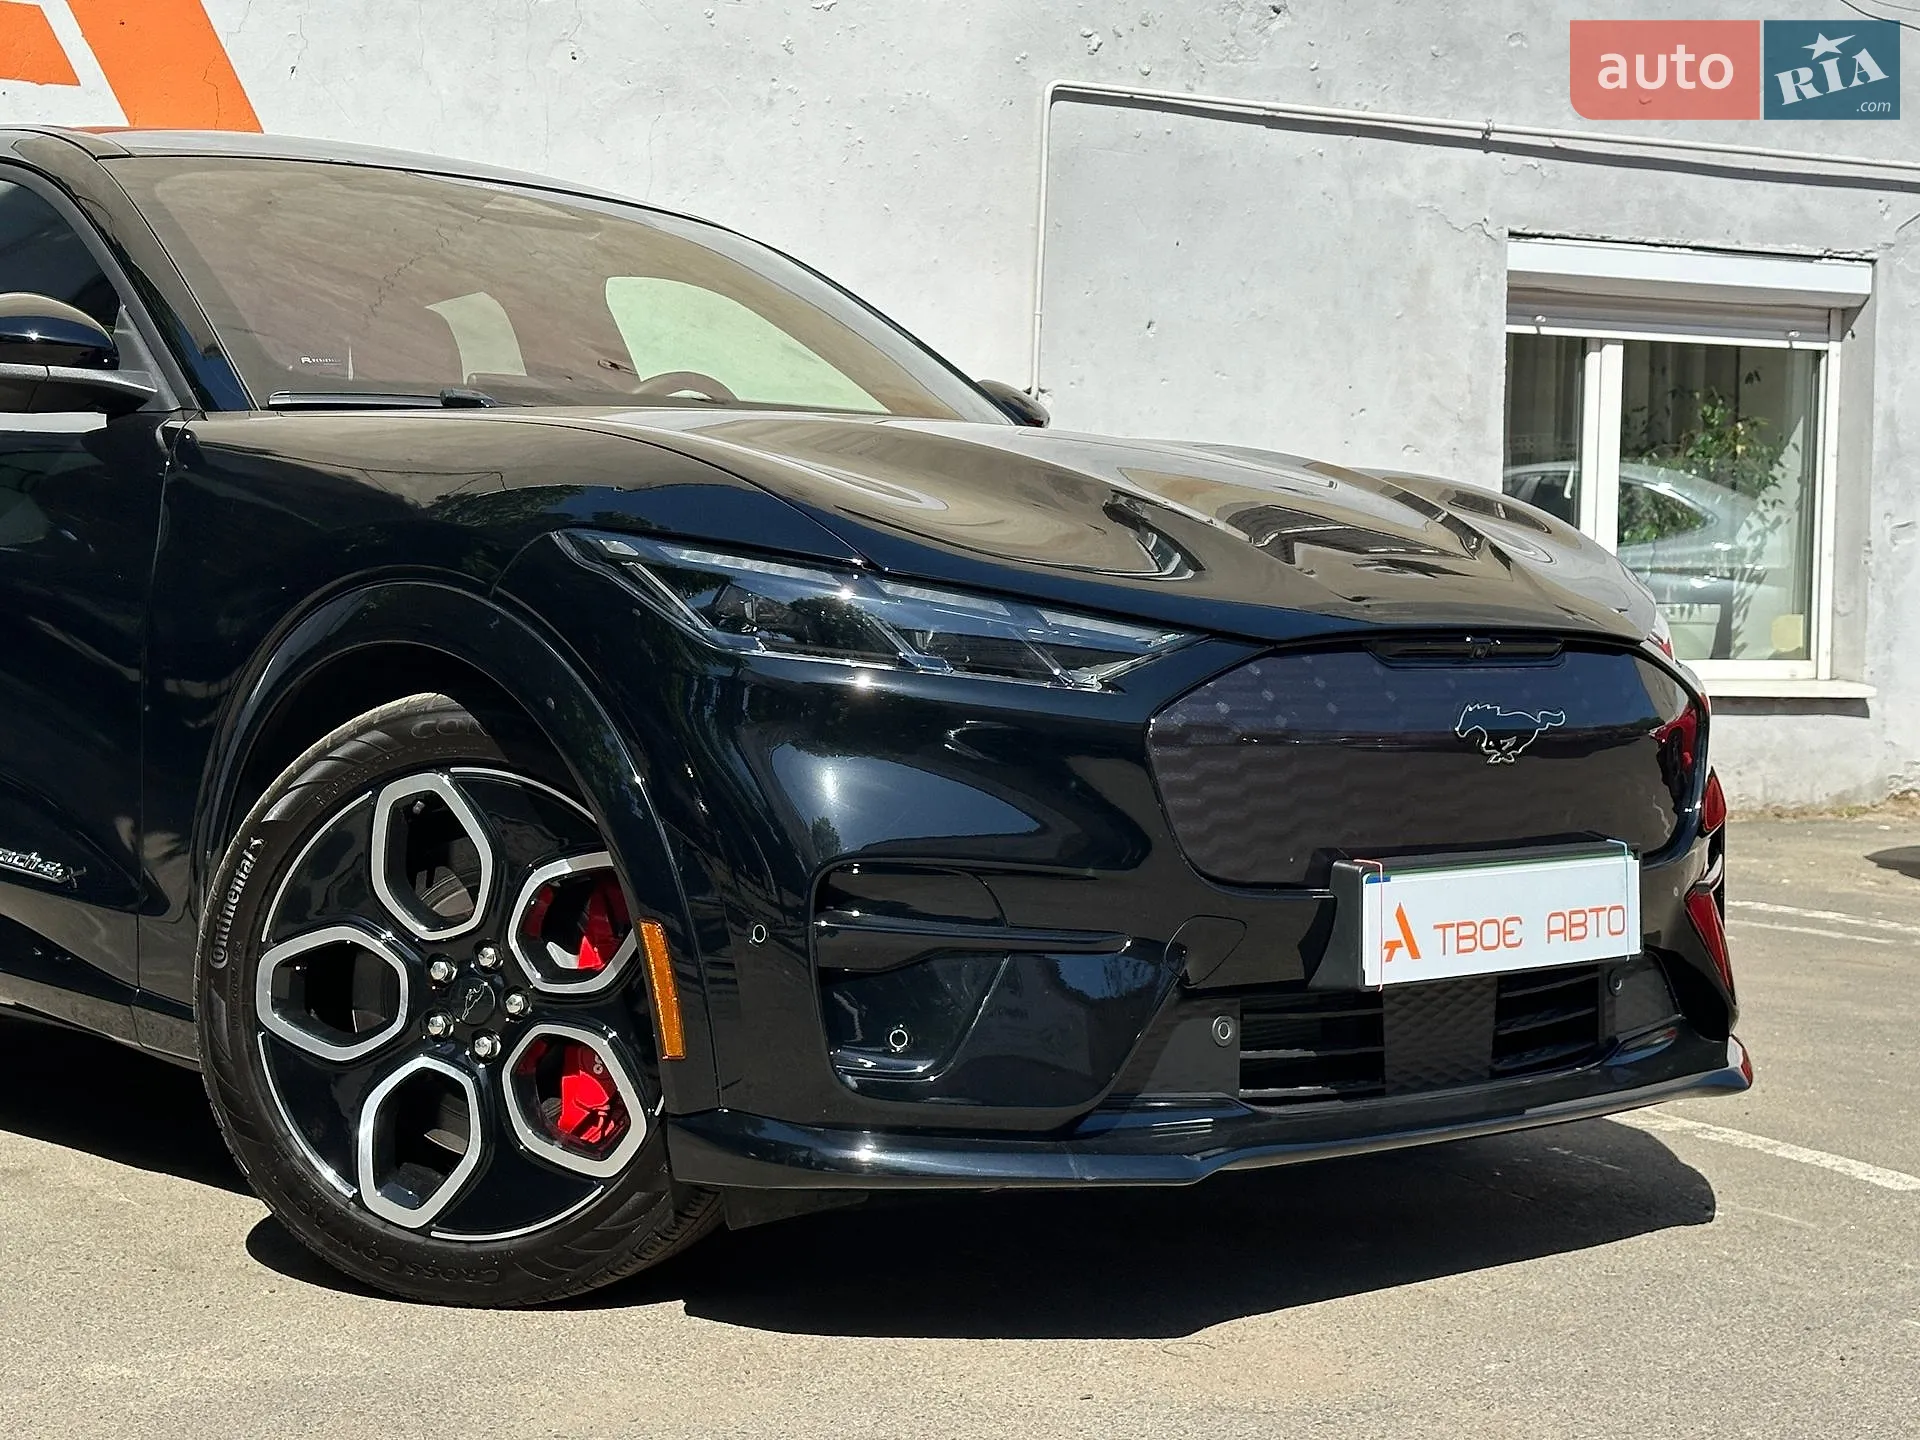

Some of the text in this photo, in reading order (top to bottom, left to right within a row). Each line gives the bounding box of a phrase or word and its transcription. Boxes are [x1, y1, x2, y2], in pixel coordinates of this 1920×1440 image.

[210, 849, 257, 969] Continental
[1433, 916, 1523, 956] ТВОЄ
[1547, 904, 1626, 944] АВТО
